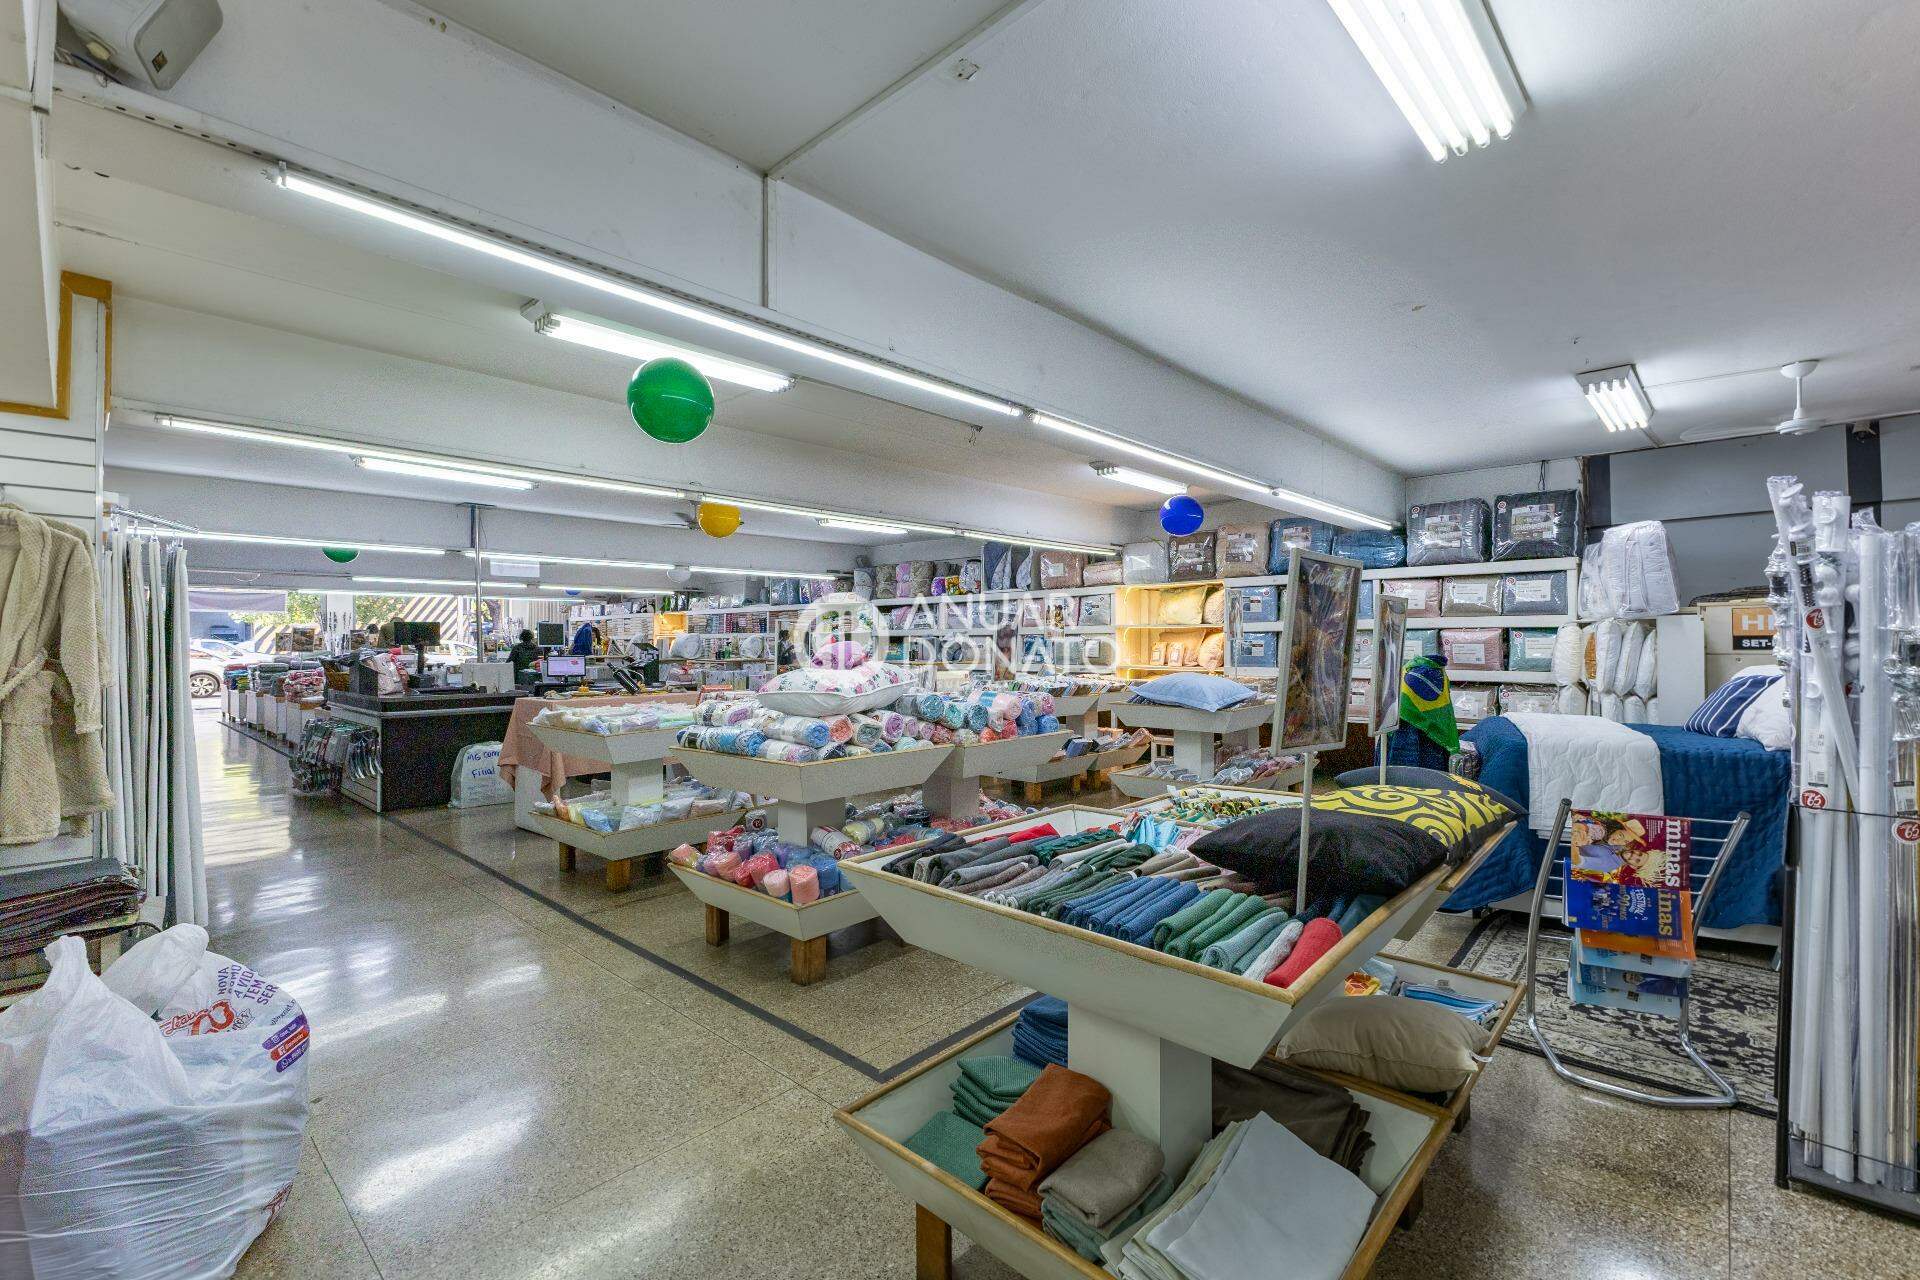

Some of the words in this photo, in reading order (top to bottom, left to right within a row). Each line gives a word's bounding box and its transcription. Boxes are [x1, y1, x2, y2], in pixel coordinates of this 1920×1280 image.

[1665, 818, 1687, 888] minas
[1657, 890, 1678, 936] inas
[242, 979, 266, 1000] TEM
[256, 984, 279, 1005] SER
